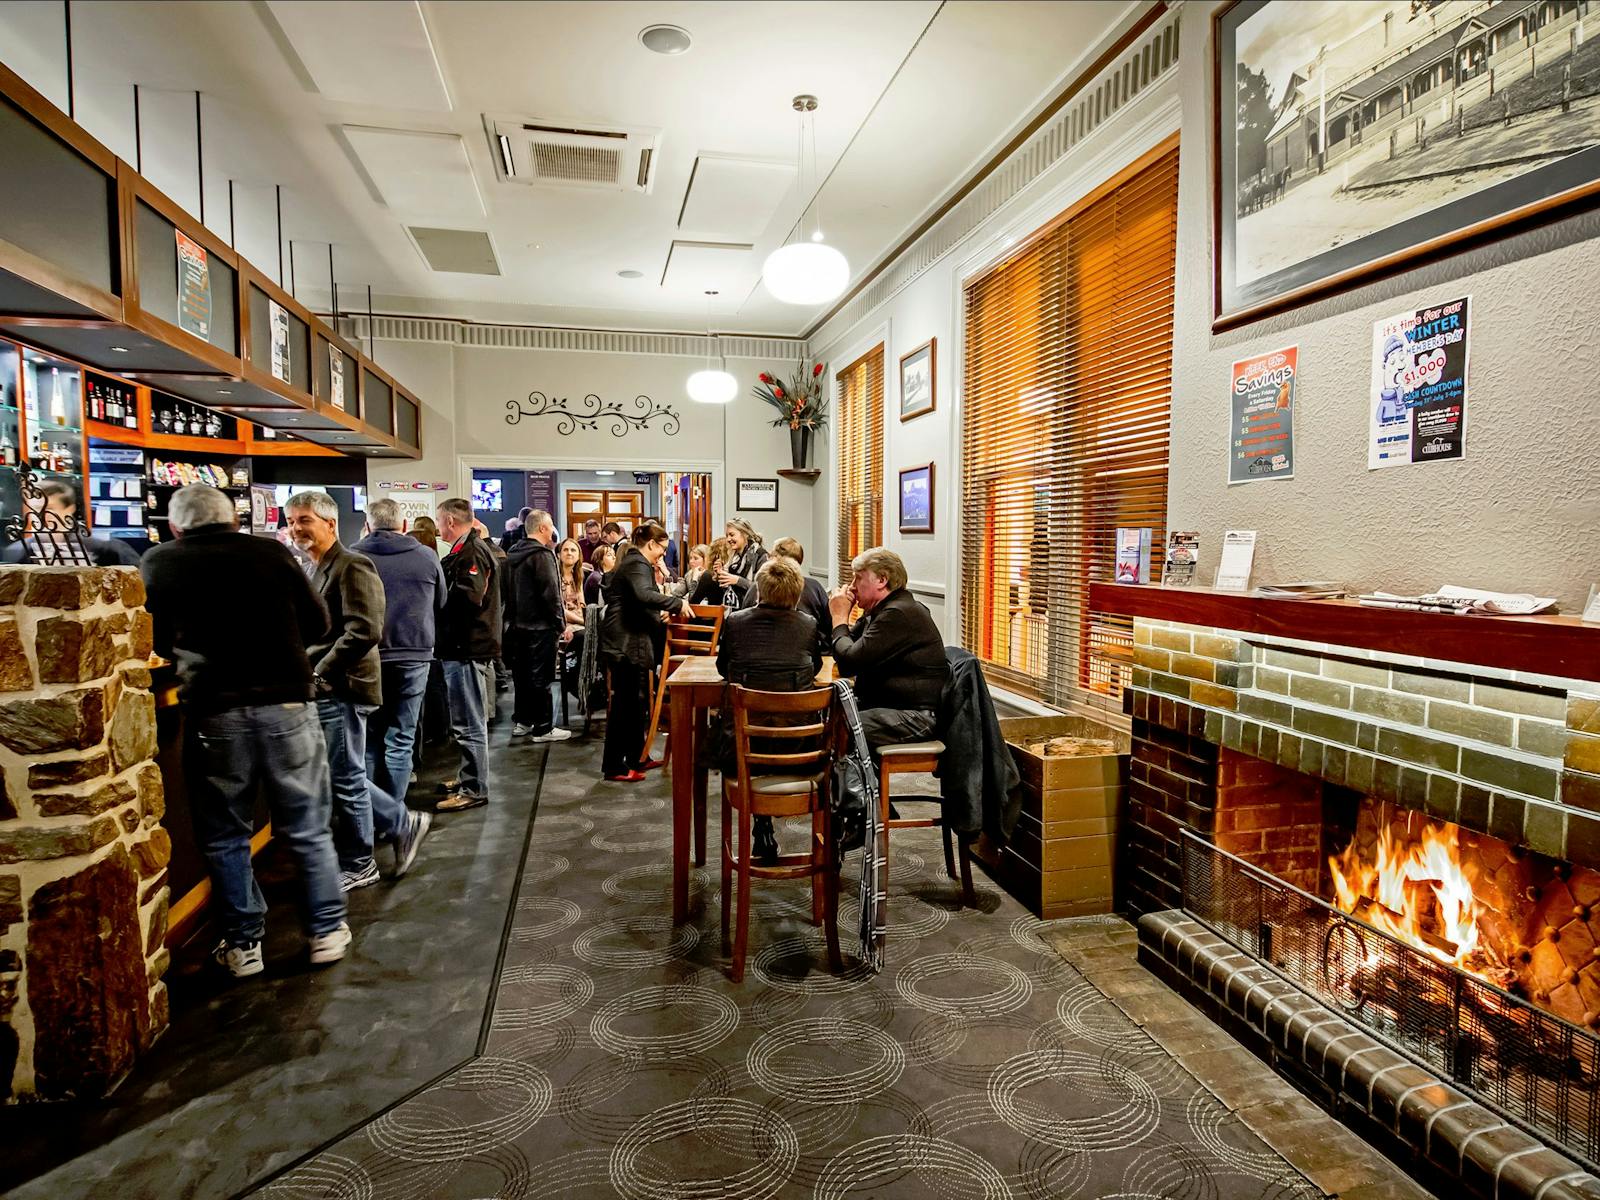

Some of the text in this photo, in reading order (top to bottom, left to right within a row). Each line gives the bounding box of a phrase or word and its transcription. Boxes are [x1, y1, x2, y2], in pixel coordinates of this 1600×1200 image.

[1400, 316, 1422, 330] time
[1423, 309, 1442, 323] for
[1443, 302, 1463, 316] our
[1405, 315, 1460, 343] WINTER
[1406, 328, 1464, 356] MEMBER'S DAY
[1235, 366, 1292, 394] Savings
[1421, 378, 1463, 397] COUNTDOWN
[408, 502, 429, 511] WIN
